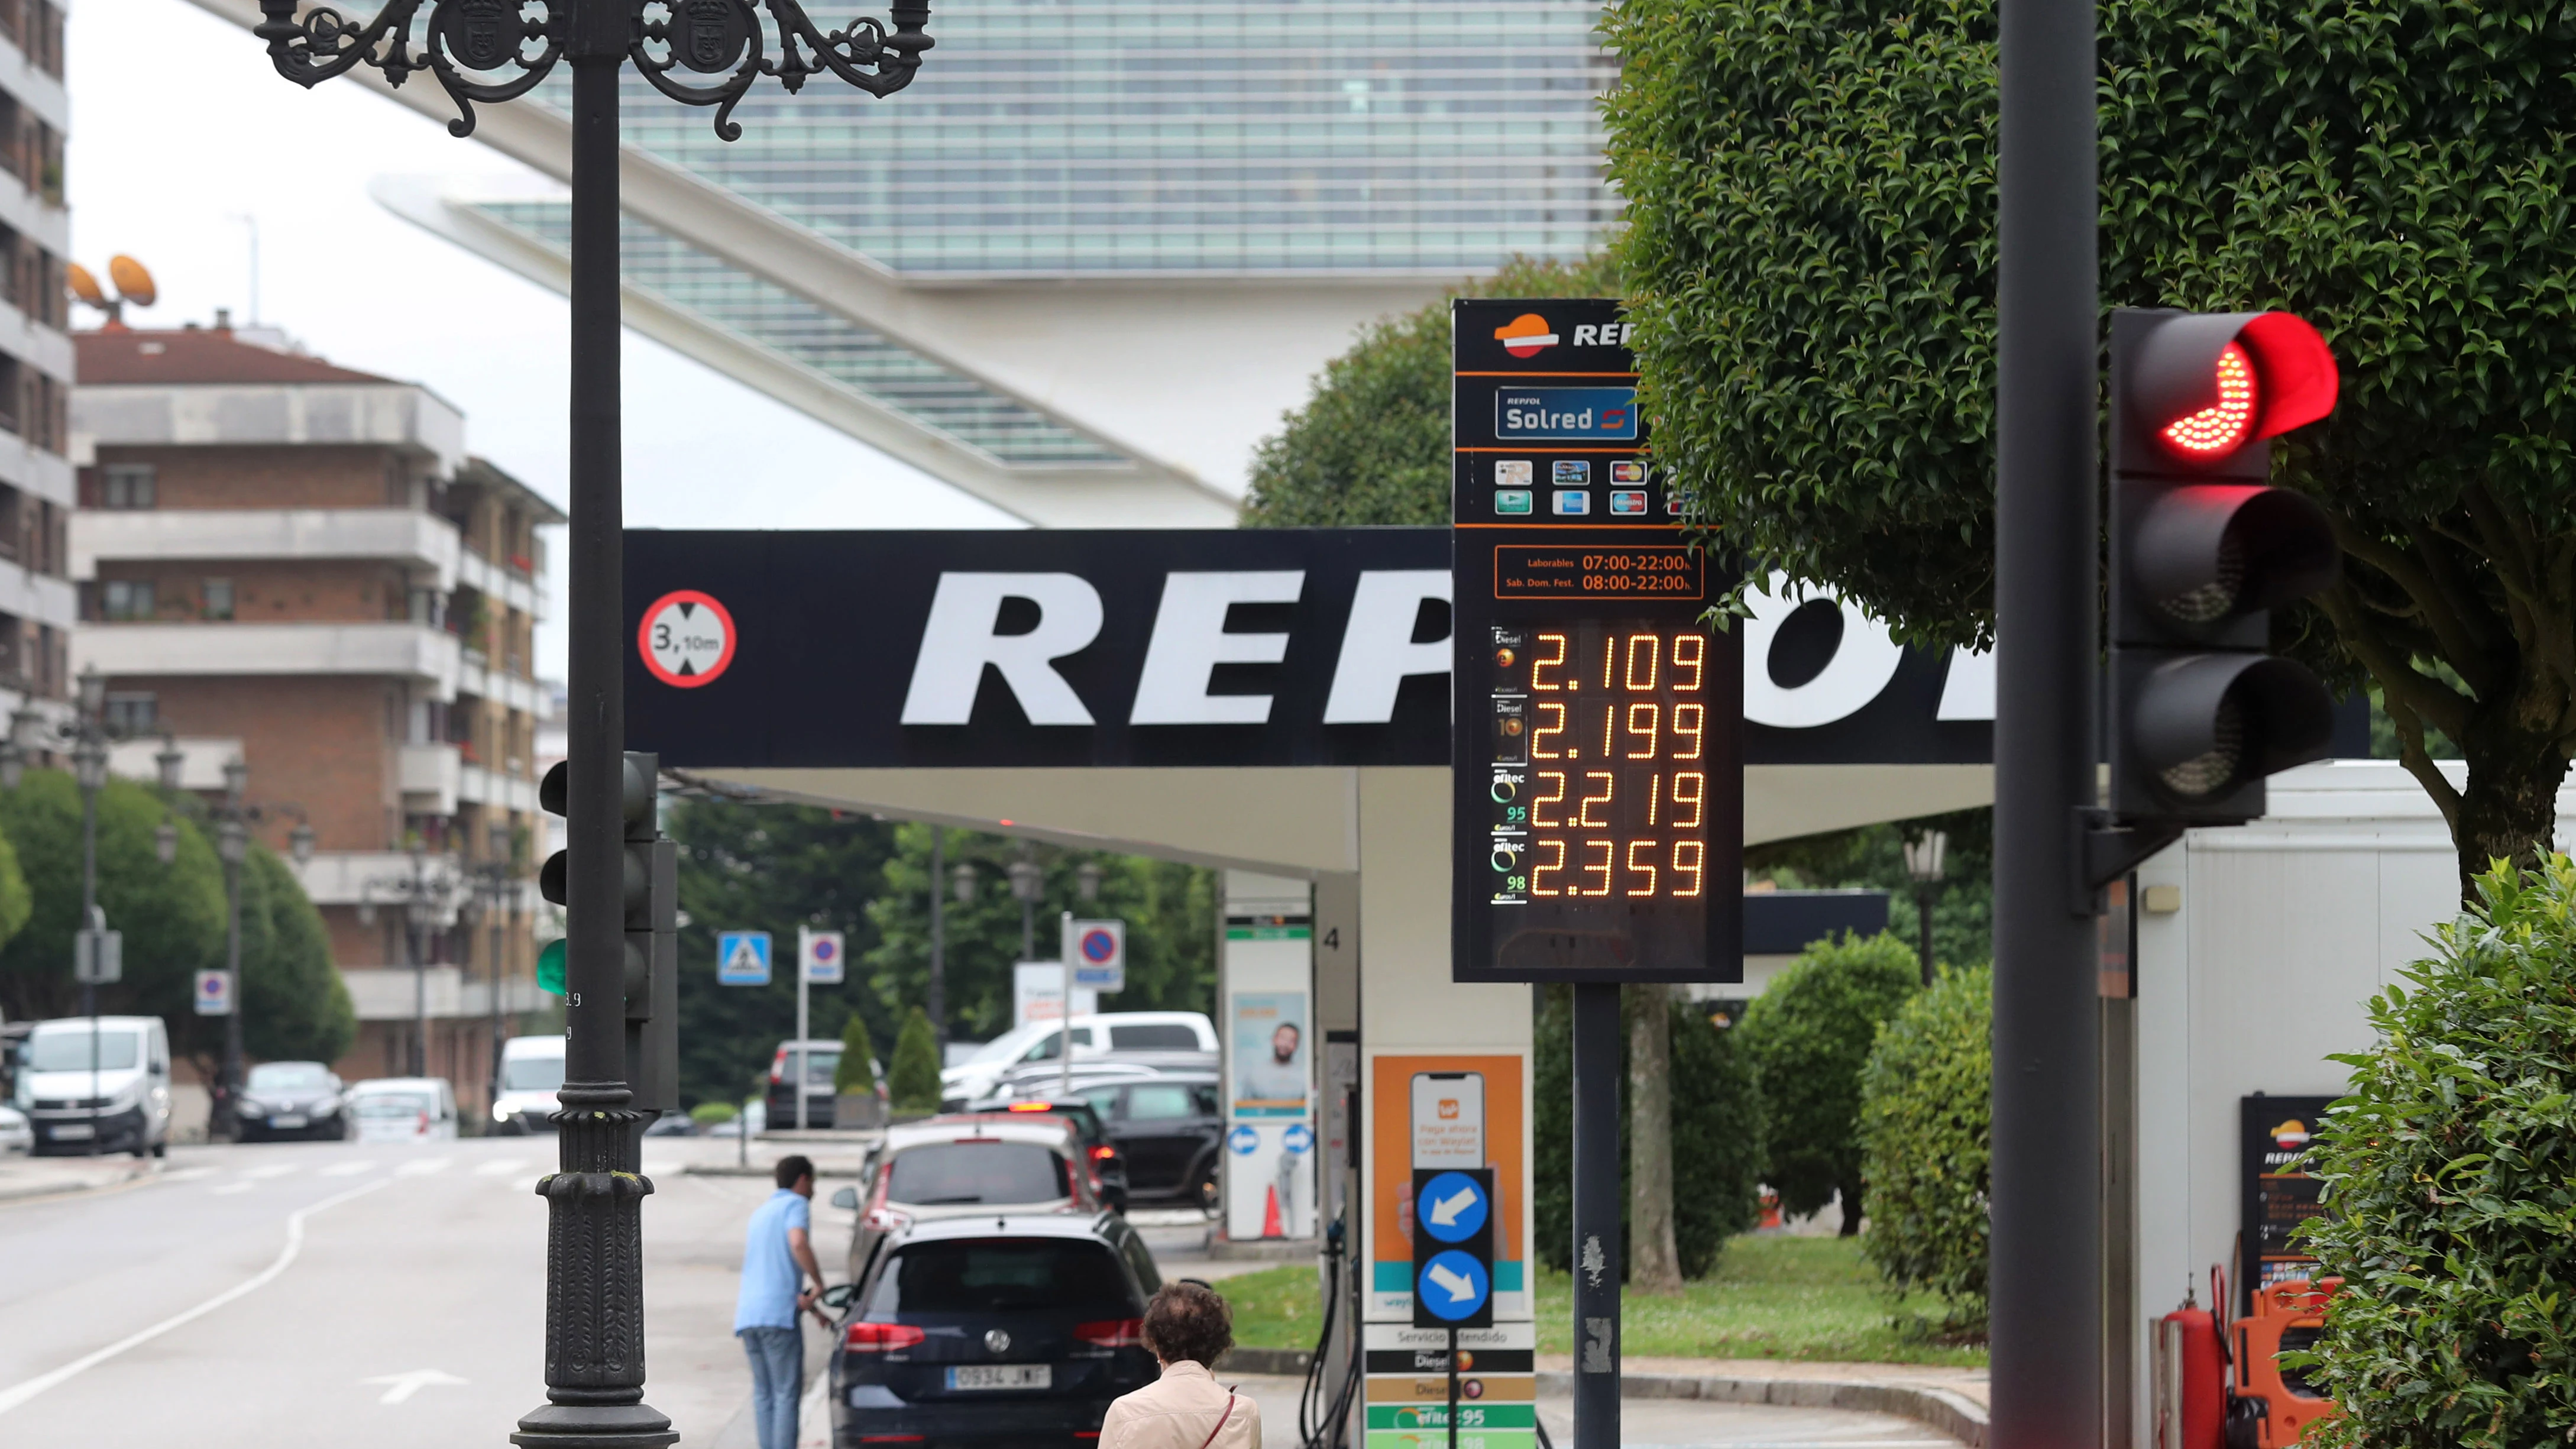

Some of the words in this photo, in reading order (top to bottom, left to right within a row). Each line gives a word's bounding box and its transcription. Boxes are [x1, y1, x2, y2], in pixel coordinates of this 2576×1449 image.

[1573, 322, 1637, 346] REP
[1507, 408, 1593, 430] Solred
[1528, 559, 1574, 568] Laborables
[1506, 578, 1525, 587] Sab.
[1528, 578, 1551, 587] Dom.
[1554, 578, 1574, 587] Fest.
[1532, 635, 1704, 691] 2.109
[1497, 704, 1522, 713] Diesel
[1532, 703, 1704, 759] 2.199
[1493, 774, 1525, 783] efitec
[1532, 772, 1704, 827] 2.219
[1507, 806, 1526, 821] 95
[1493, 842, 1525, 852] efitec
[1532, 840, 1704, 896] 2.359
[1507, 875, 1526, 890] 98
[1323, 927, 1339, 951] 4
[1397, 1331, 1446, 1343] Servicio
[1457, 1331, 1507, 1343] tendido
[1462, 1409, 1485, 1426] 95
